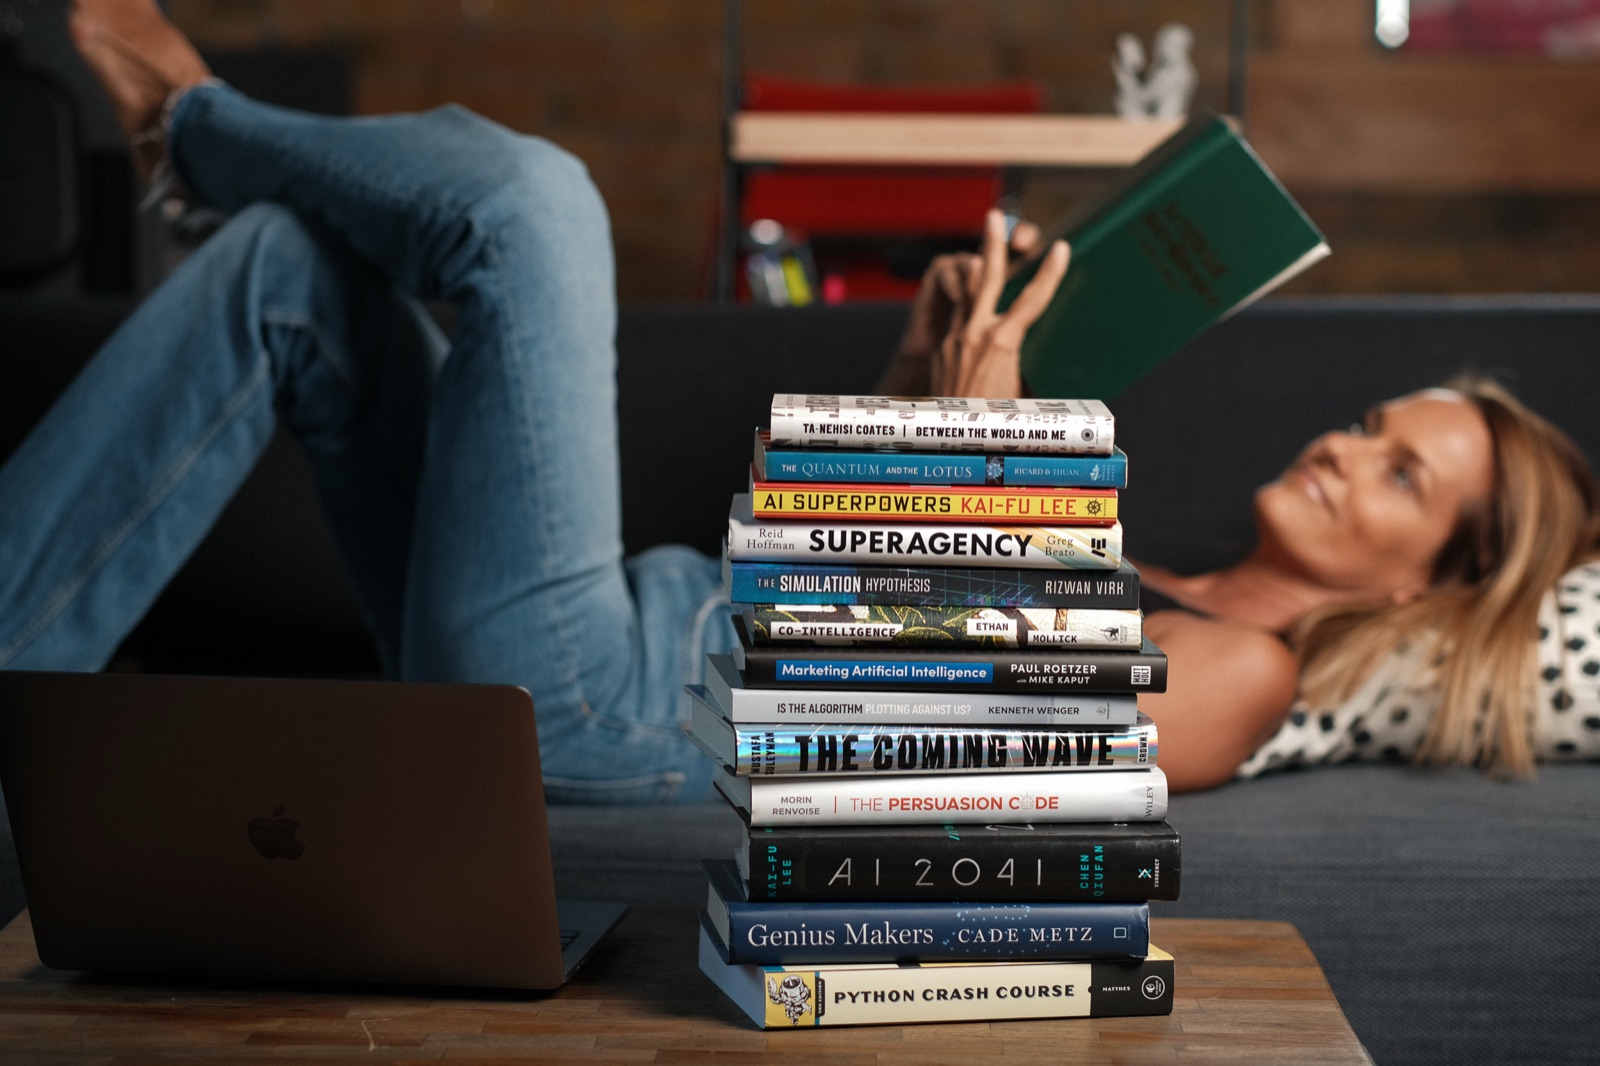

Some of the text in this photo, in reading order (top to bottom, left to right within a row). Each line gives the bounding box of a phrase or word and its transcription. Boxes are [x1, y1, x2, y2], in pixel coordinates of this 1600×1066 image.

[803, 423, 895, 436] TA-NEHISI COATES
[916, 426, 1066, 441] BETWEEN THE WORLD AND ME
[781, 463, 972, 478] THE QUANTUM AND THE LOTUS
[1014, 467, 1044, 475] RICARD
[1053, 468, 1079, 476] THUAN
[763, 493, 950, 512] AI SUPERPOWERS
[961, 497, 1076, 515] KAI-FU LEE
[759, 528, 783, 539] Reid
[1047, 535, 1073, 547] Greg
[747, 539, 795, 550] Hoffman
[809, 529, 1033, 556] SUPERAGENCY
[1045, 547, 1075, 557] Beato
[758, 575, 931, 593] THE SIMULATION HYPOTHESIS
[1045, 580, 1124, 595] RIZWAN VIRK
[778, 626, 896, 638] CO-INTELLIGENCE
[976, 622, 1008, 631] ETHAN
[1033, 634, 1077, 643] MOLLICK
[782, 664, 987, 680] Marketing Artificial Intelligence
[1010, 663, 1097, 674] PAUL ROETZER
[1132, 667, 1141, 683] MATT
[1141, 667, 1149, 683] HOLT
[1029, 675, 1054, 684] MIKE
[1057, 676, 1090, 684] KAPUT
[777, 703, 971, 715] IS THE ALGORITHM PLOTTING AGAINST US?
[988, 706, 1080, 715] KENNETH WENGER
[751, 736, 761, 774] MUSTAFA
[765, 732, 775, 775] SULEYMAN
[795, 730, 1114, 771] THE COMING WAVE
[1139, 736, 1148, 763] CROWN
[781, 796, 812, 804] MORIN
[850, 797, 883, 811] THE
[888, 796, 1003, 811] PERSUASION
[772, 807, 820, 815] RENVOISE
[768, 845, 778, 897] KAI-FU
[782, 859, 792, 885] LEE
[828, 857, 1042, 886] AI 2041
[1080, 854, 1090, 889] CHEN
[1094, 845, 1103, 897] QIUFAN
[748, 921, 934, 947] Genius Makers
[957, 927, 1093, 943] CADE METZ
[834, 985, 1075, 1004] PYTHON CRASH COURSE
